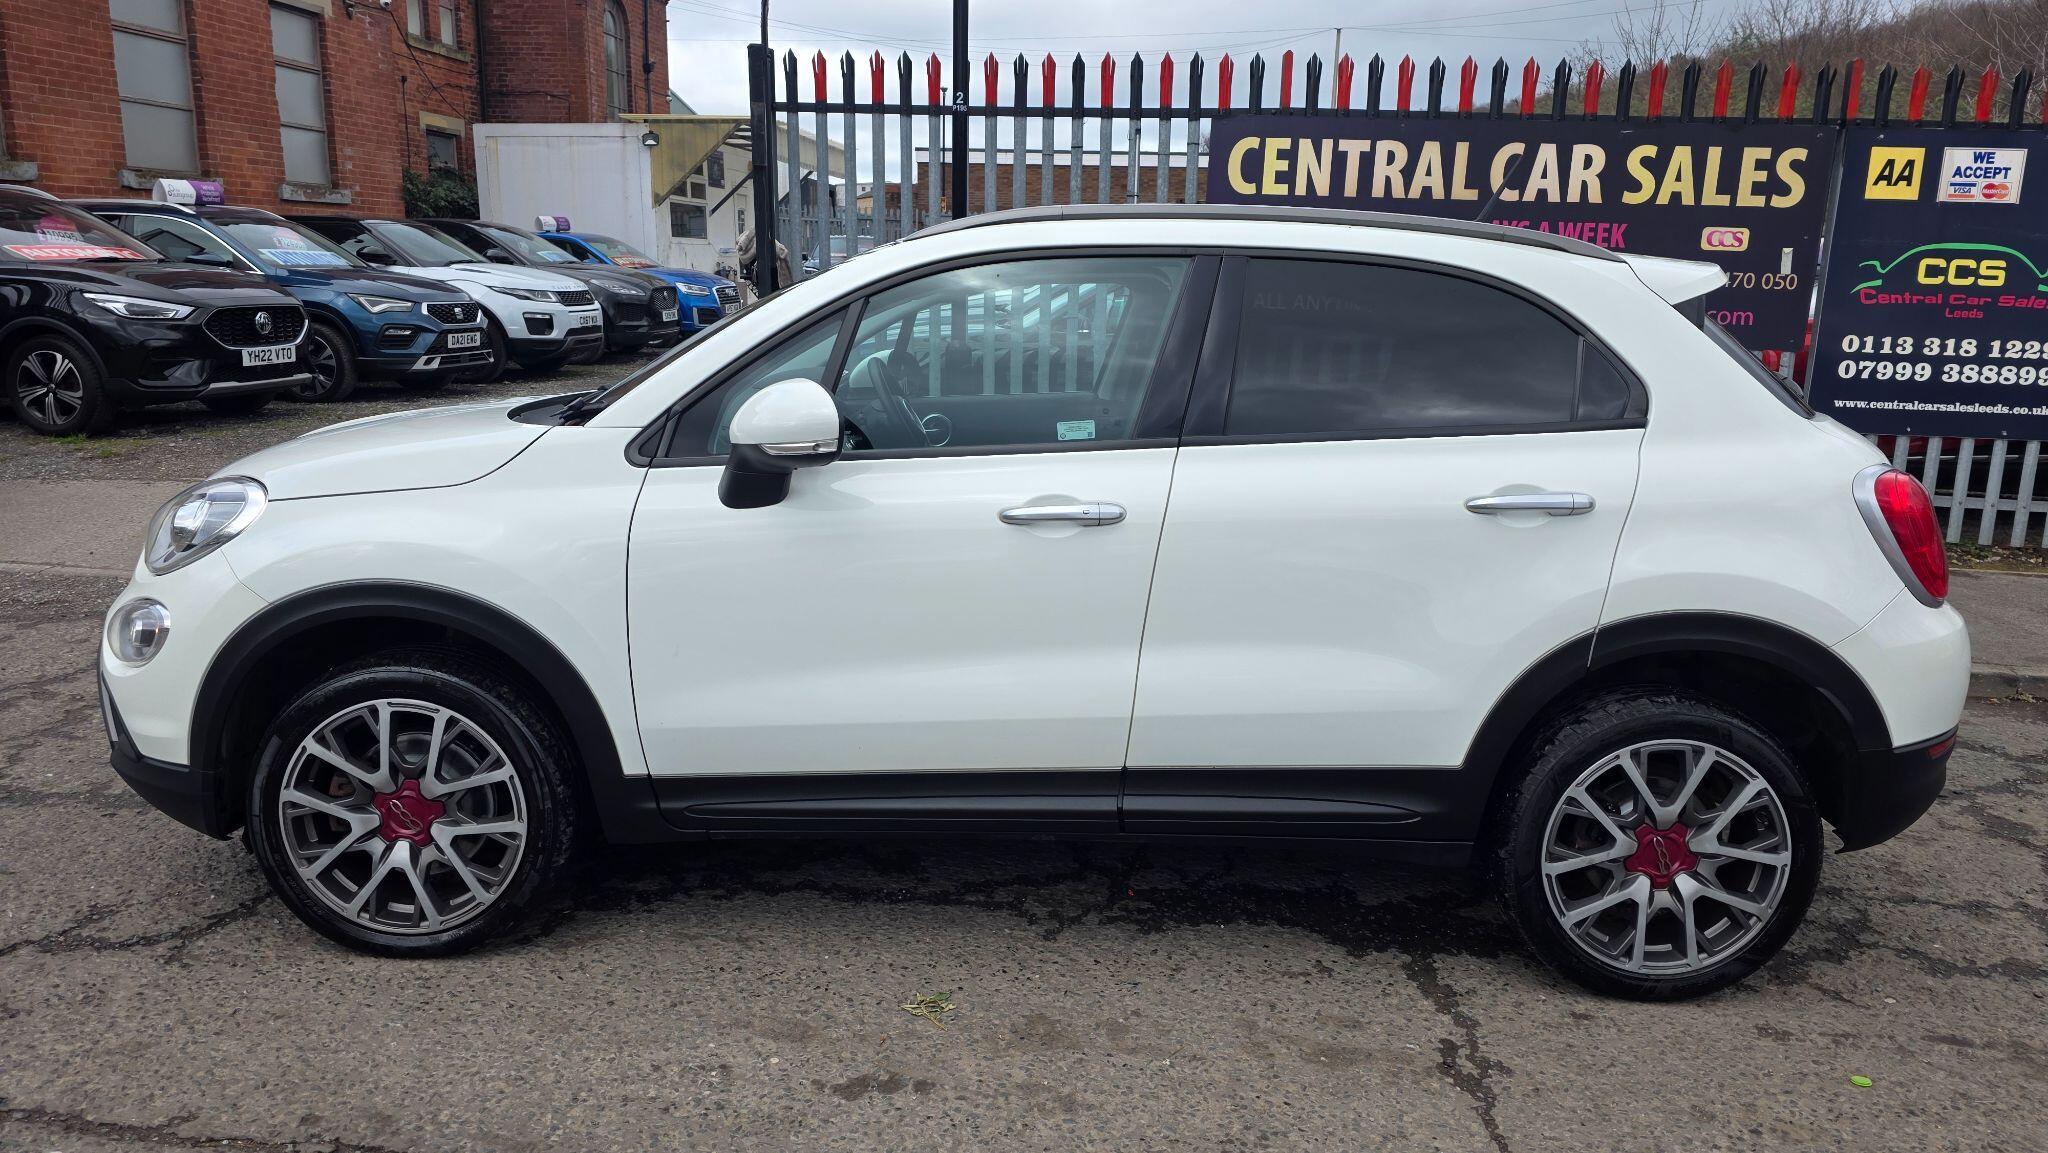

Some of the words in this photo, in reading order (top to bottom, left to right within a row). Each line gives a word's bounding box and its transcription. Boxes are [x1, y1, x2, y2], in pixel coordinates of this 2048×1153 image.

[955, 91, 964, 104] 2
[1973, 151, 1996, 165] WE
[1227, 136, 1479, 201] CENTRAL
[1489, 142, 1606, 204] CAR
[1621, 144, 1809, 208] SALES
[1872, 158, 1916, 187] AA
[1952, 165, 2012, 180] ACCEPT
[1559, 222, 1629, 249] WEEK
[1706, 230, 1745, 248] CCS
[1761, 273, 1798, 290] 050
[1917, 257, 2006, 287] CCS
[1859, 288, 1943, 305] Central
[1948, 294, 1992, 306] Car
[1997, 295, 2048, 309] Sale
[1944, 307, 1985, 319] Leeds
[247, 349, 273, 363] YH22
[274, 347, 292, 361] VTO
[1841, 334, 1914, 356] 0113
[1922, 337, 1978, 357] 318
[1837, 359, 1932, 382] 07999
